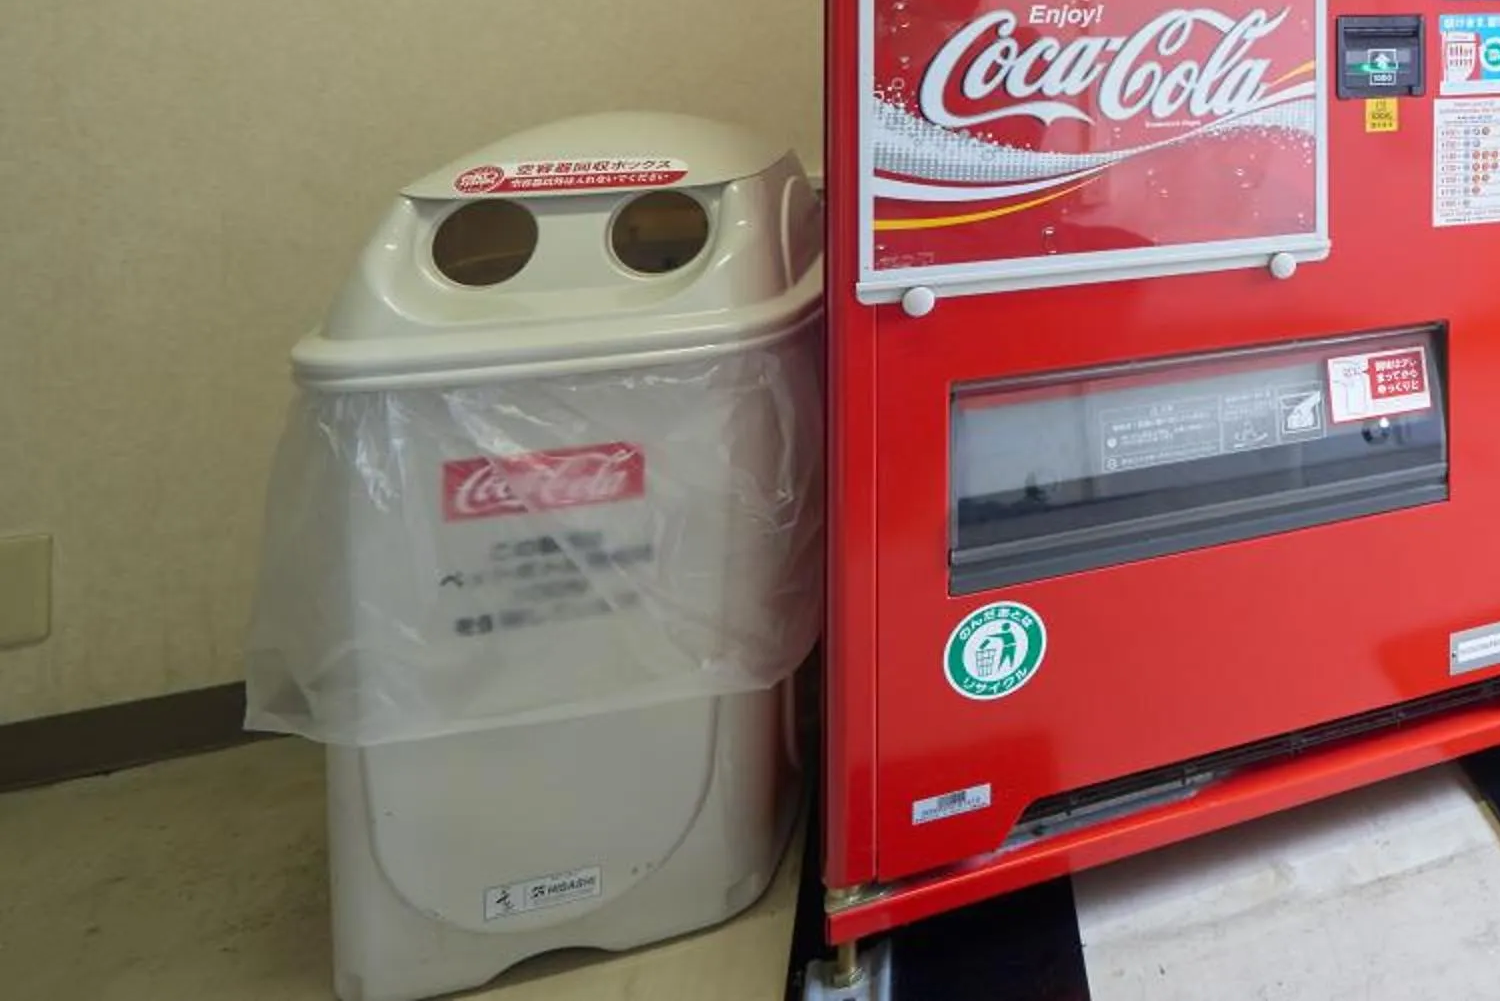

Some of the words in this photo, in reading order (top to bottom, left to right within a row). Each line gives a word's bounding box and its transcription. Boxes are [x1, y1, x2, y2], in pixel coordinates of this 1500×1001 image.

[1029, 4, 1105, 26] Enjoy!
[919, 5, 1292, 130] Coca-Cola
[963, 667, 1028, 694] リサイクル
